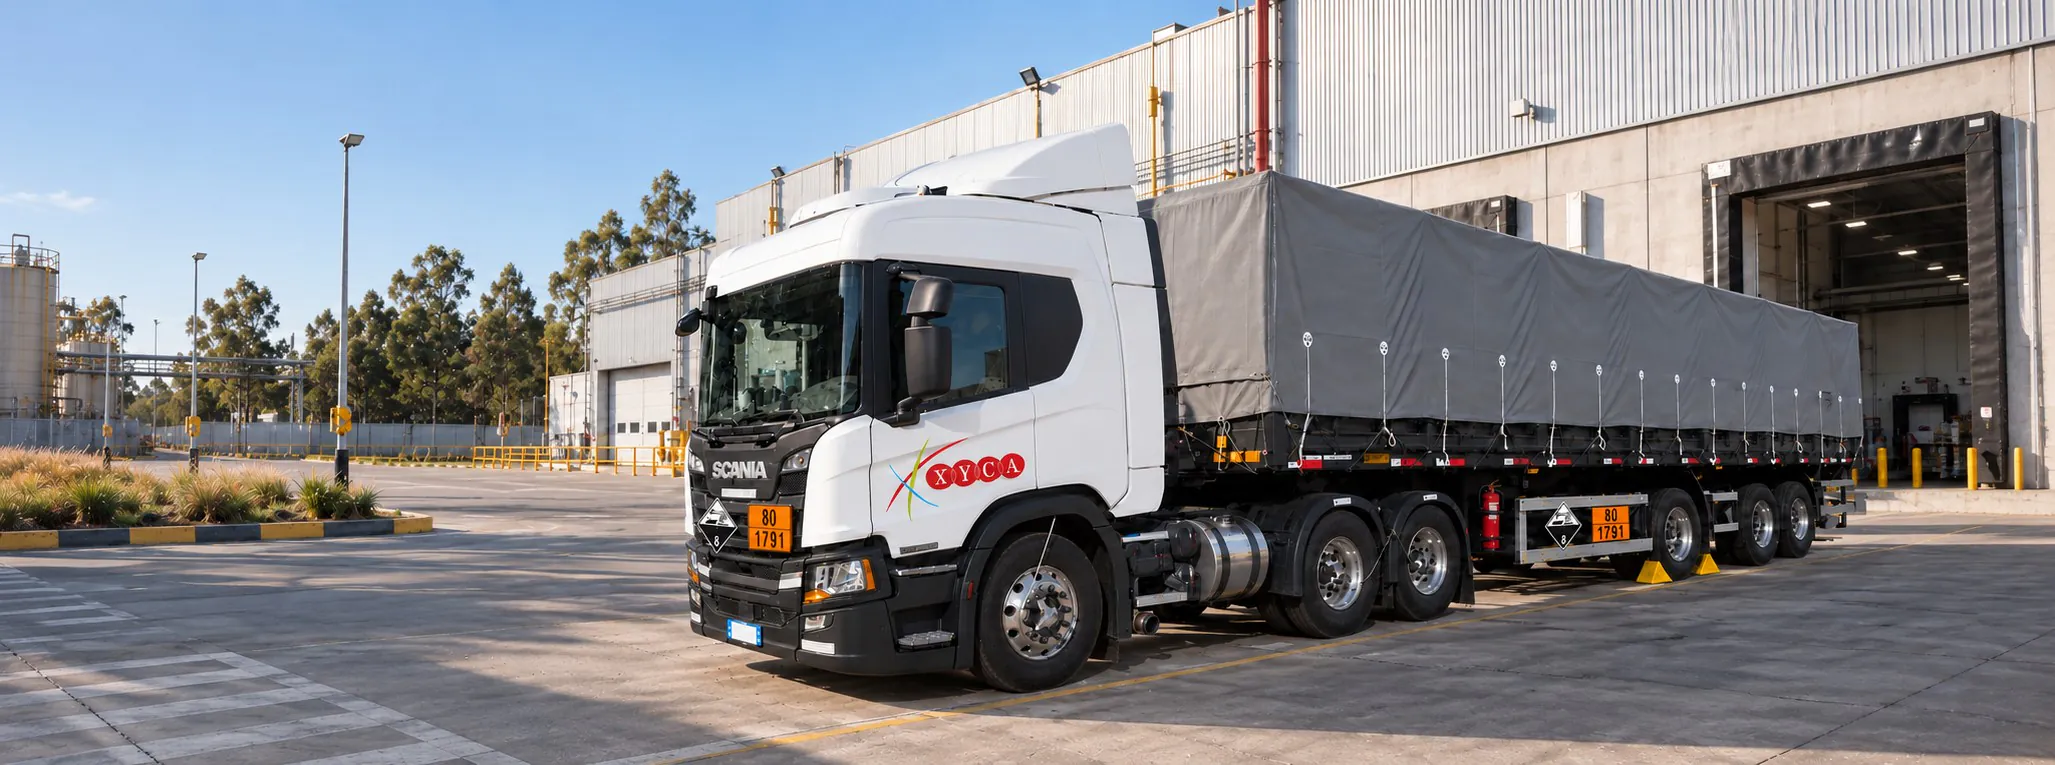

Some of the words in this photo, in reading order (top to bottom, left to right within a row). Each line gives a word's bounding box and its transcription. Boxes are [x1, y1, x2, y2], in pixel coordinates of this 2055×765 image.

[711, 460, 768, 480] SCANIA
[933, 457, 1020, 486] XYCA
[761, 508, 777, 527] 80
[1604, 507, 1618, 522] 80
[754, 530, 785, 549] 1791
[1560, 534, 1567, 545] 8
[1597, 524, 1624, 540] 1791
[713, 535, 720, 547] 8
